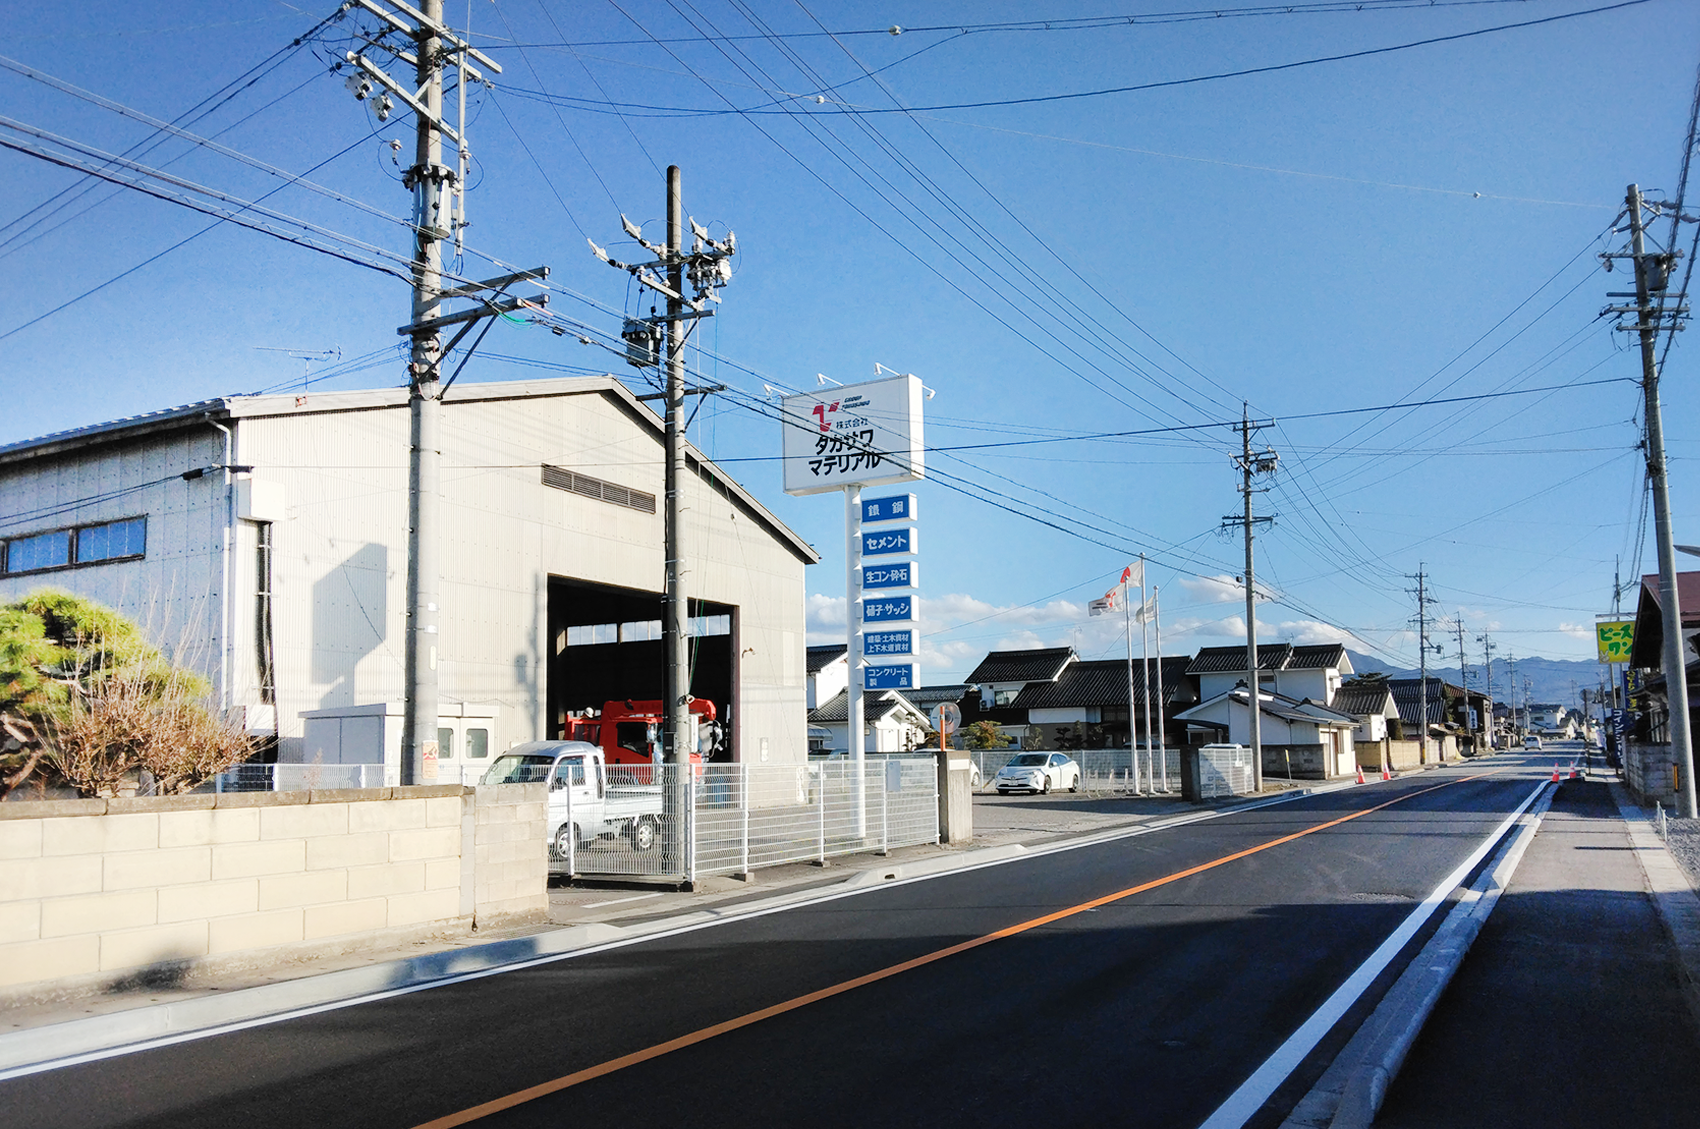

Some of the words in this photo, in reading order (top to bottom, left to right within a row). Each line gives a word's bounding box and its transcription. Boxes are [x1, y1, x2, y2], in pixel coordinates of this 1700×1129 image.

[836, 418, 868, 430] 株式会社
[808, 452, 882, 476] マテリアル
[866, 535, 907, 550] セメント
[1600, 624, 1633, 641] ピース
[868, 667, 909, 677] コンクリート
